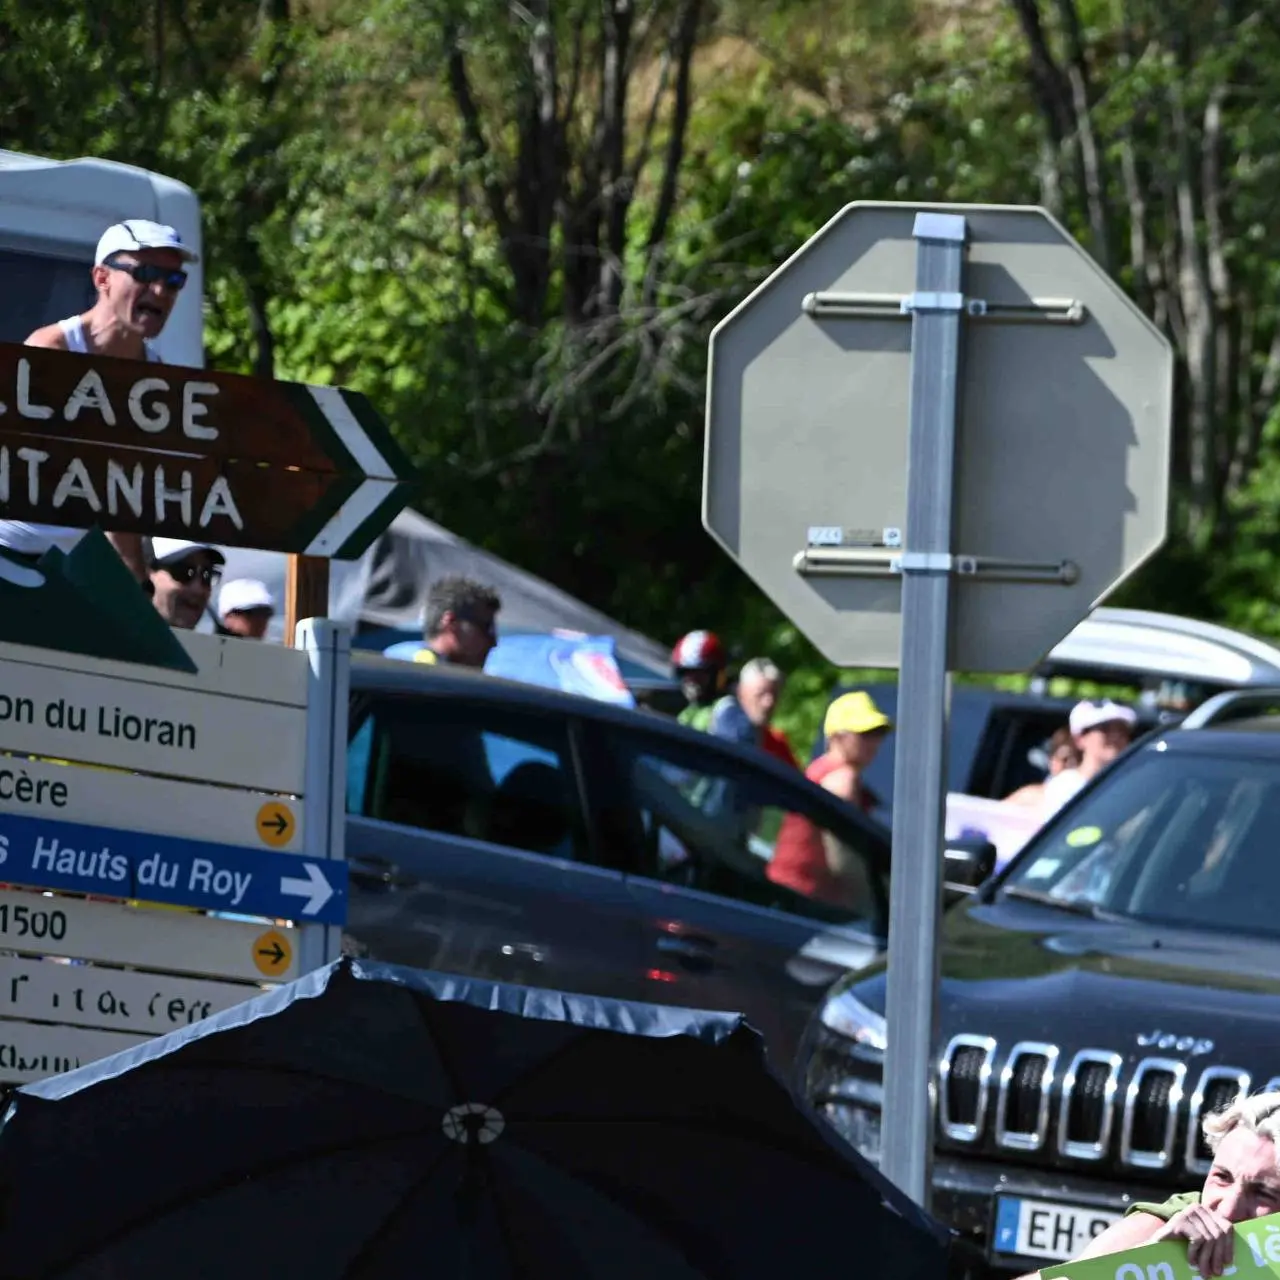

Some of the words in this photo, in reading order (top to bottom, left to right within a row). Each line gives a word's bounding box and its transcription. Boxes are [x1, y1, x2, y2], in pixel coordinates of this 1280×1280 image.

[0, 357, 220, 440] LAGE
[45, 699, 86, 732] du
[98, 706, 195, 750] Lioran
[0, 770, 68, 807] Cère
[31, 836, 128, 881] Hauts
[137, 853, 179, 888] du
[188, 858, 251, 906] Roy
[0, 904, 67, 940] 1500
[1136, 1029, 1214, 1057] Jeep
